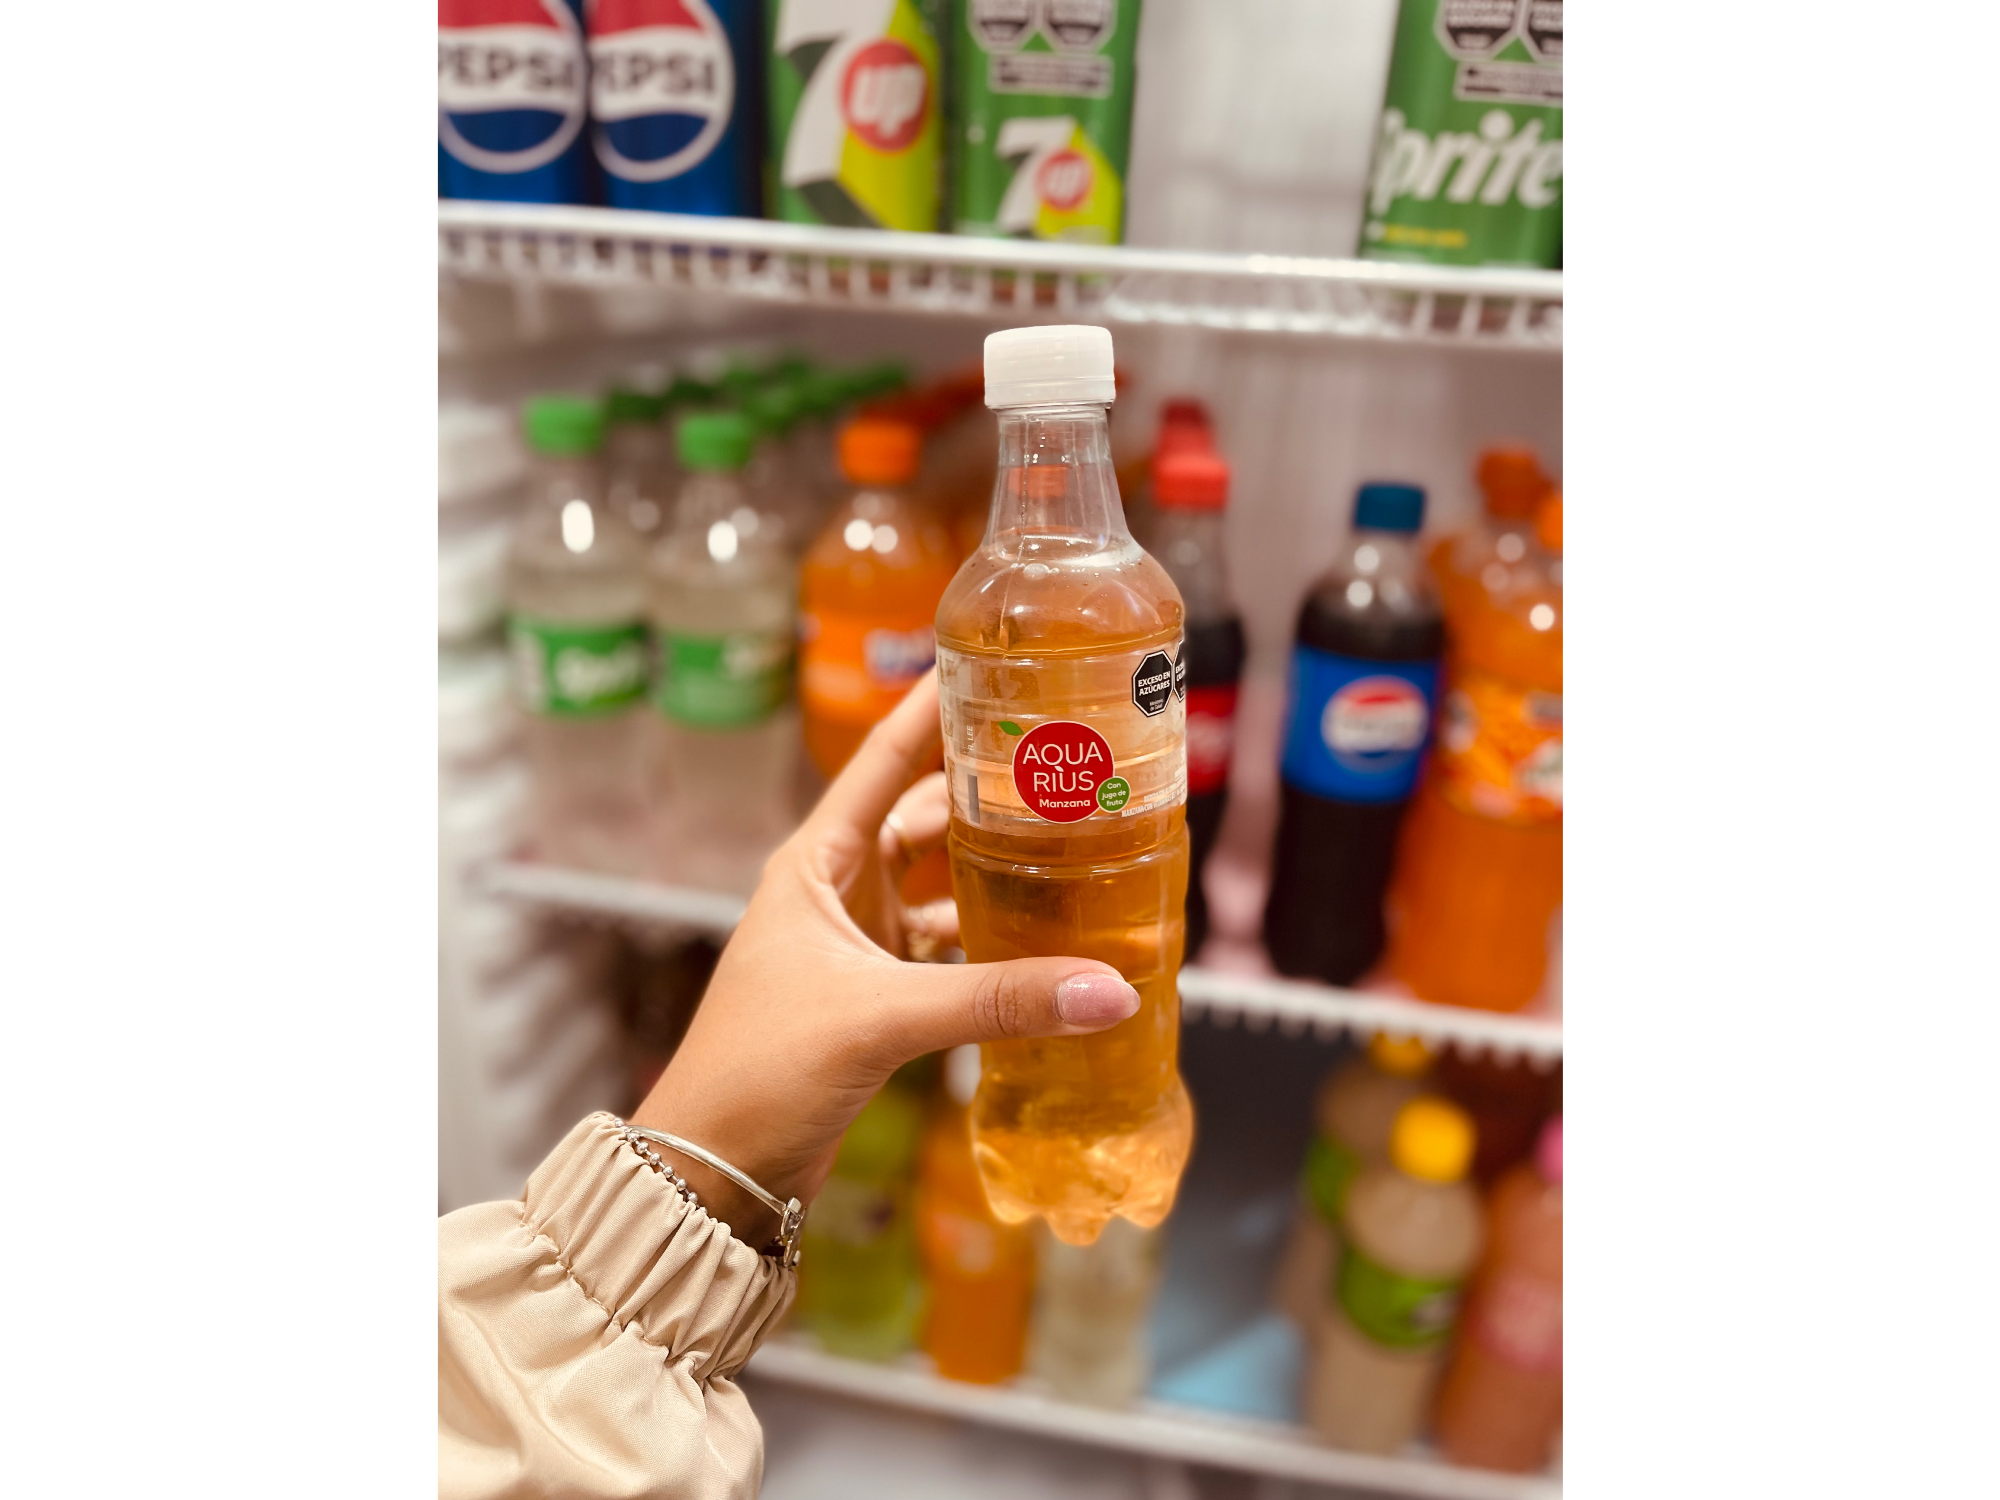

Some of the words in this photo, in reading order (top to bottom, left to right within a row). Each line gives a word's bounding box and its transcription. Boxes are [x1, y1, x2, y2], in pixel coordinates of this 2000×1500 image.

[1138, 674, 1162, 688] EXCESO
[1163, 670, 1171, 680] EN
[1022, 741, 1104, 766] AQUA
[1107, 782, 1122, 790] Con
[1101, 791, 1117, 801] jugo
[1039, 798, 1091, 809] Manzana
[1106, 799, 1124, 807] fruta
